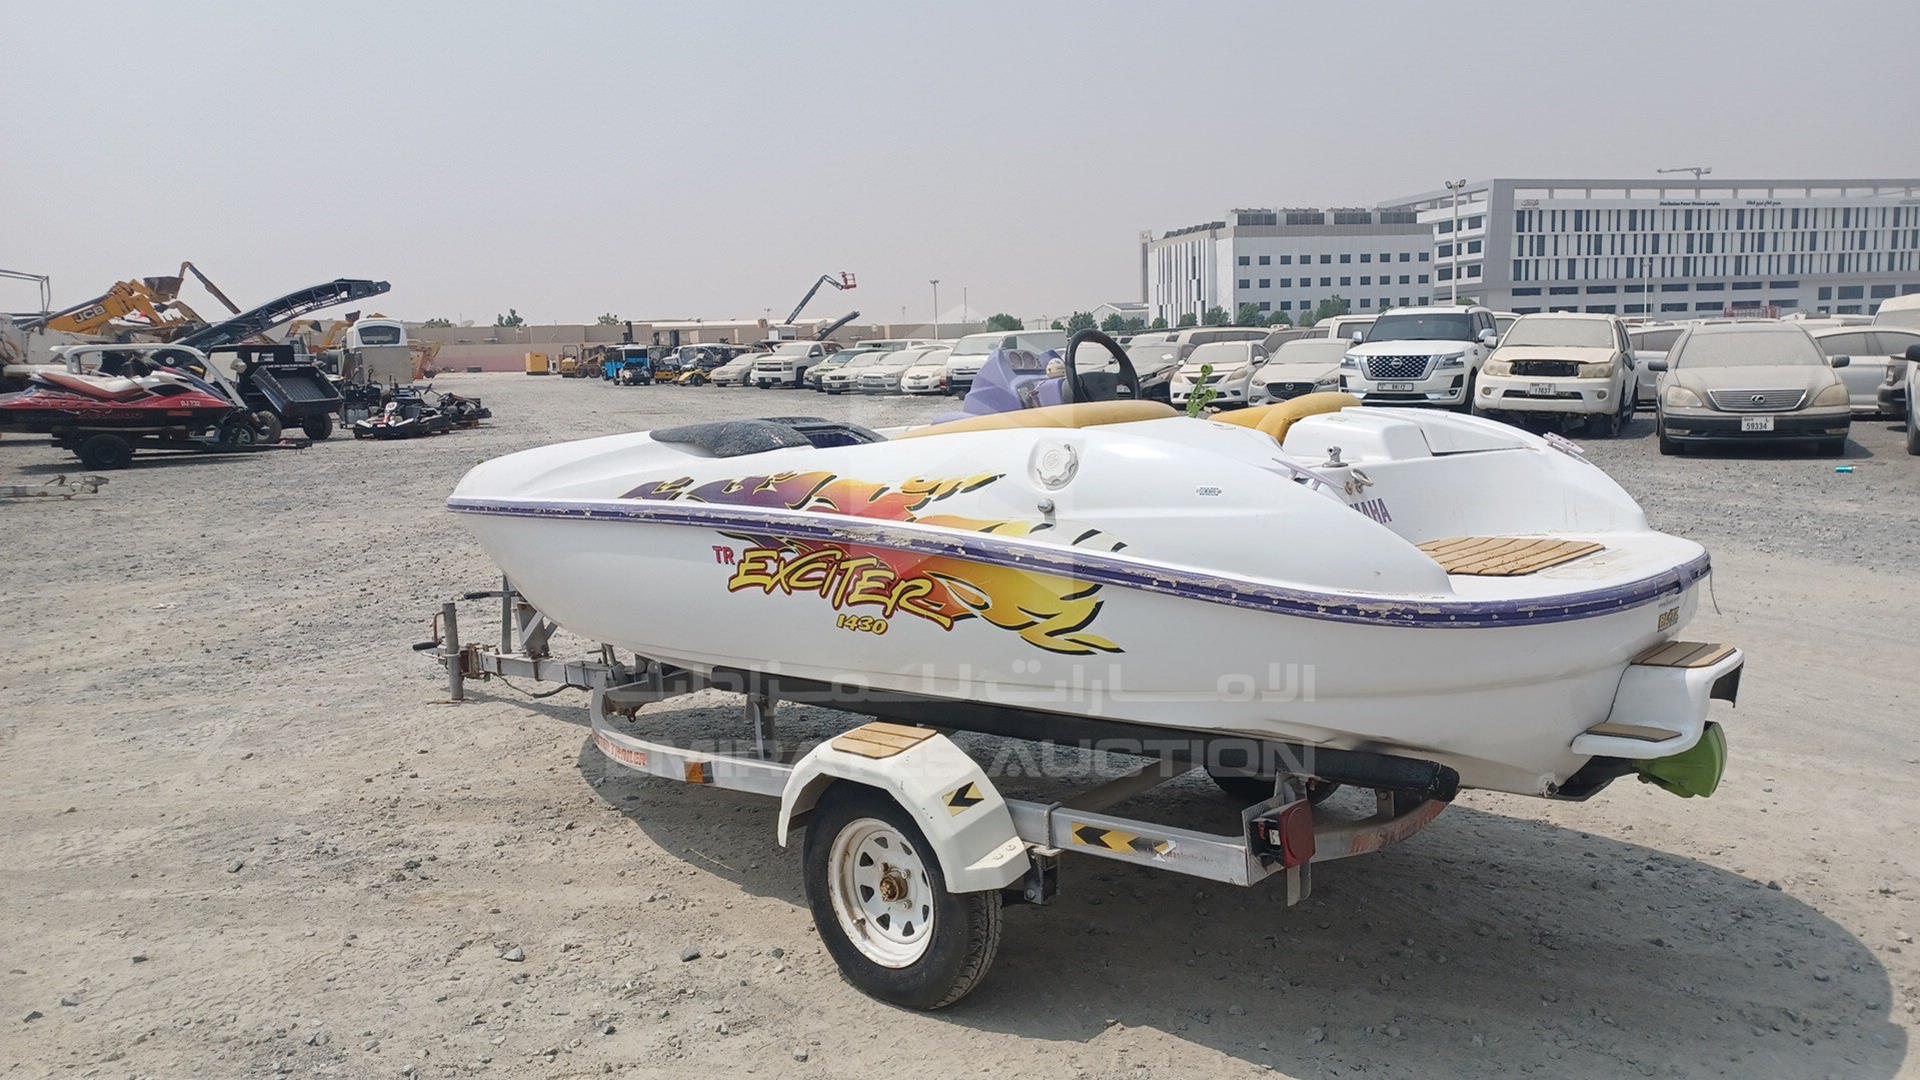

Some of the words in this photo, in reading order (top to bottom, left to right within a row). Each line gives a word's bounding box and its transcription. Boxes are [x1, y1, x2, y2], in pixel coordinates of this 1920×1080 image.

[75, 305, 105, 323] JCB
[712, 545, 735, 565] TR
[728, 547, 955, 631] EXCITER
[836, 614, 889, 634] 1430
